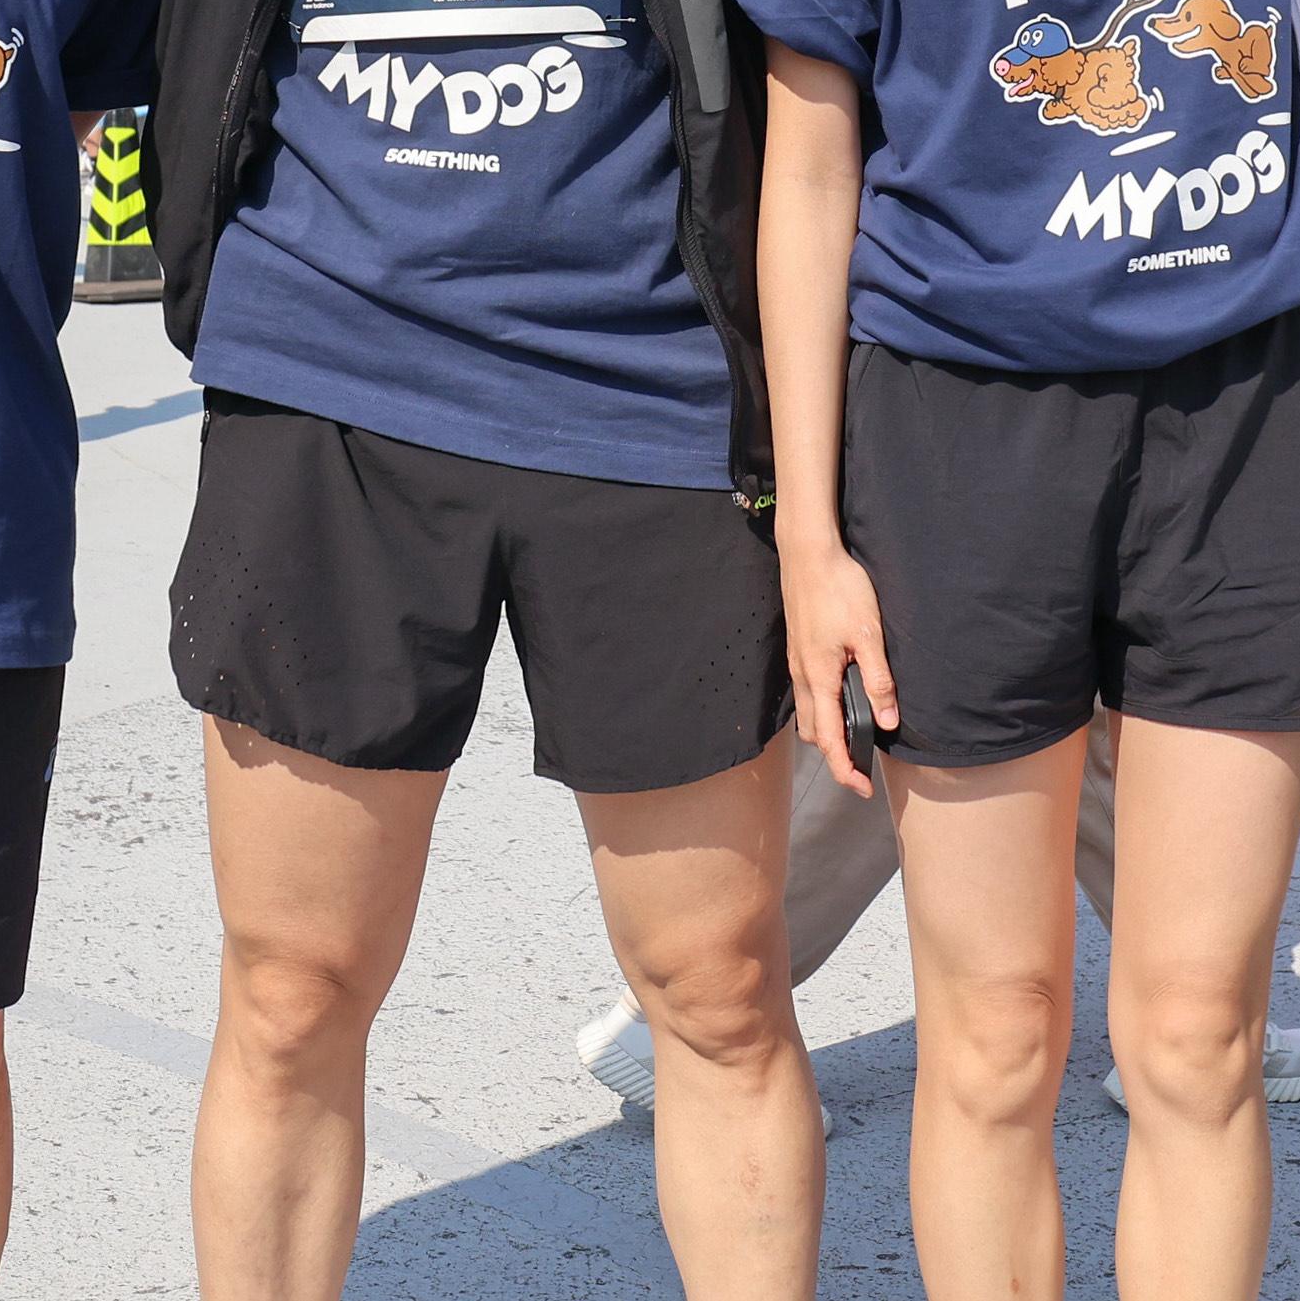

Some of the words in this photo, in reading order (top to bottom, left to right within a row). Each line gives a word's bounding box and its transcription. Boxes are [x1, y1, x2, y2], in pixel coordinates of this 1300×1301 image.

[317, 41, 444, 134] MY
[442, 45, 584, 135] DOG
[1045, 166, 1178, 241] MY
[1175, 130, 1286, 231] DOG
